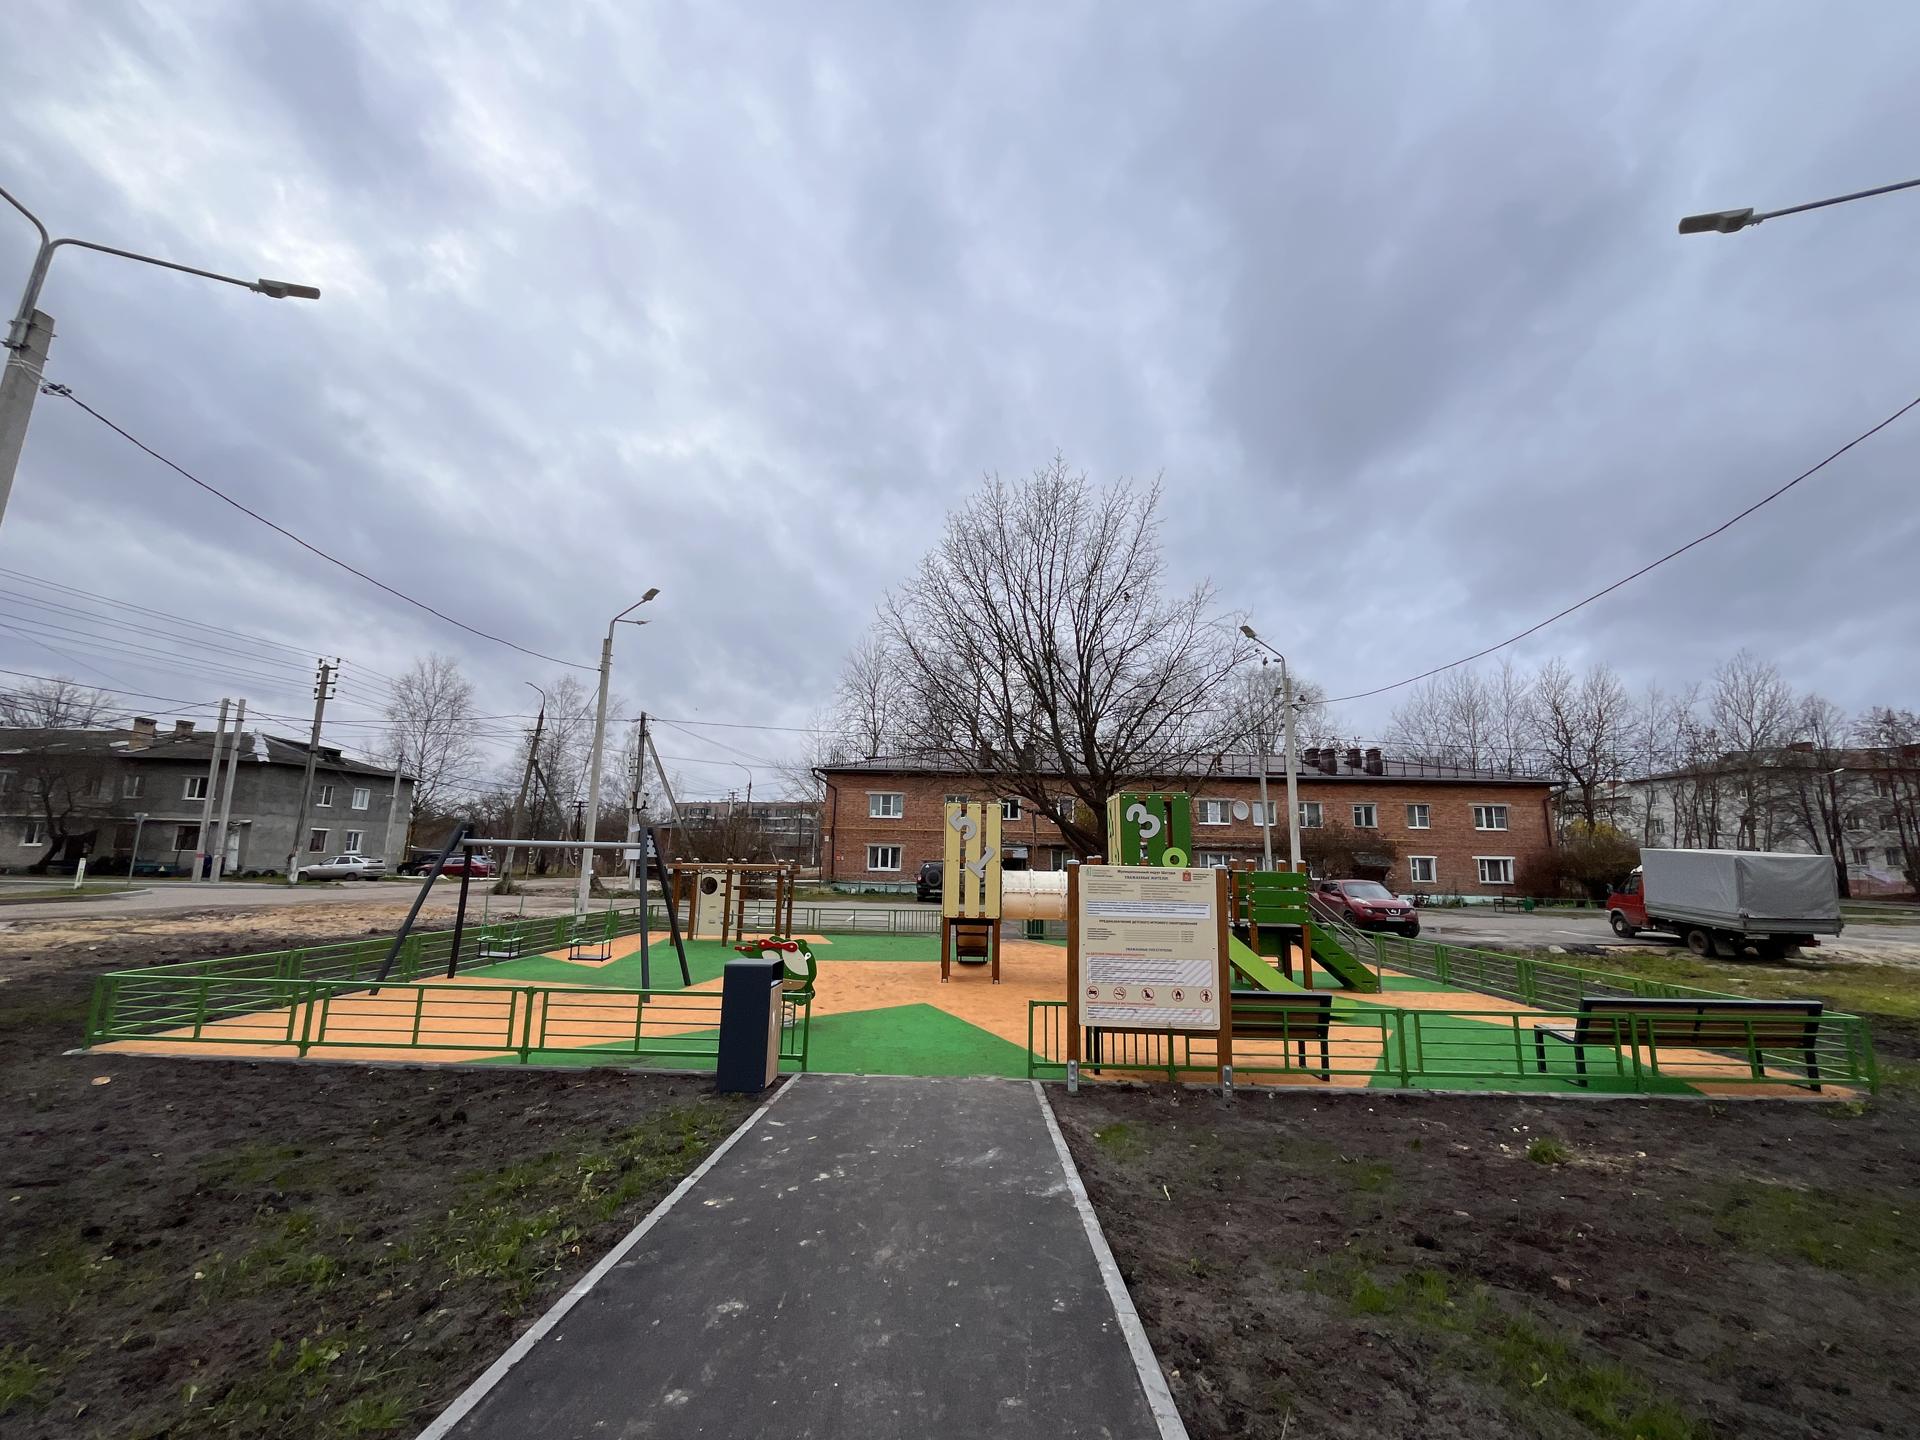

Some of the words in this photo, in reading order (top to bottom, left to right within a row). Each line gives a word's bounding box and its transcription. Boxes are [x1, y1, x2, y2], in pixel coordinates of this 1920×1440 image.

[949, 808, 977, 840] 5
[1126, 803, 1160, 838] 3
[966, 846, 996, 878] 1
